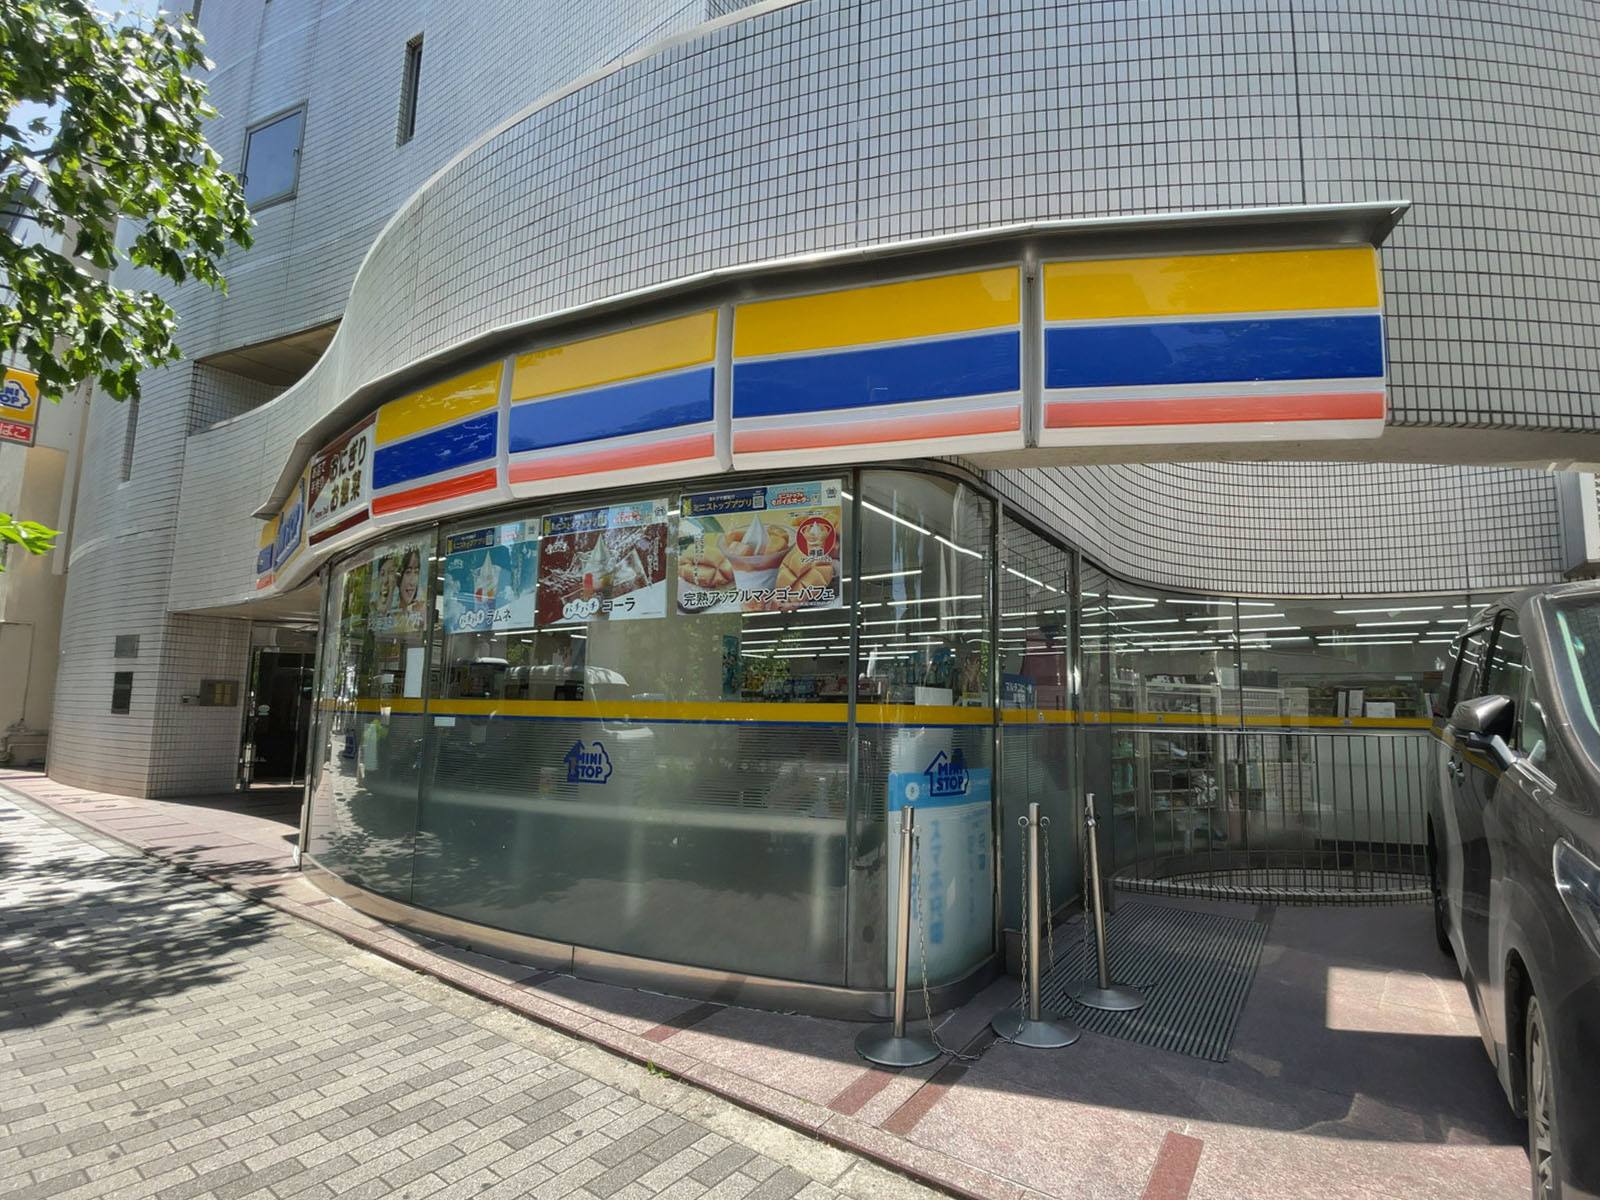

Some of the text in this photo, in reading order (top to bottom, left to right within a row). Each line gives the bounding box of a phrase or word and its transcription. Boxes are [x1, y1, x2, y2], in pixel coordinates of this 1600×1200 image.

[330, 436, 366, 483] おにぎり
[693, 498, 752, 513] ミニストップアプリ
[683, 586, 835, 607] 完熟アップルマンゴーパフェ
[602, 597, 636, 613] コーラ
[487, 609, 512, 624] ラムネ
[577, 752, 602, 765] MINI
[574, 765, 603, 778] STOP
[936, 776, 964, 791] STOP
